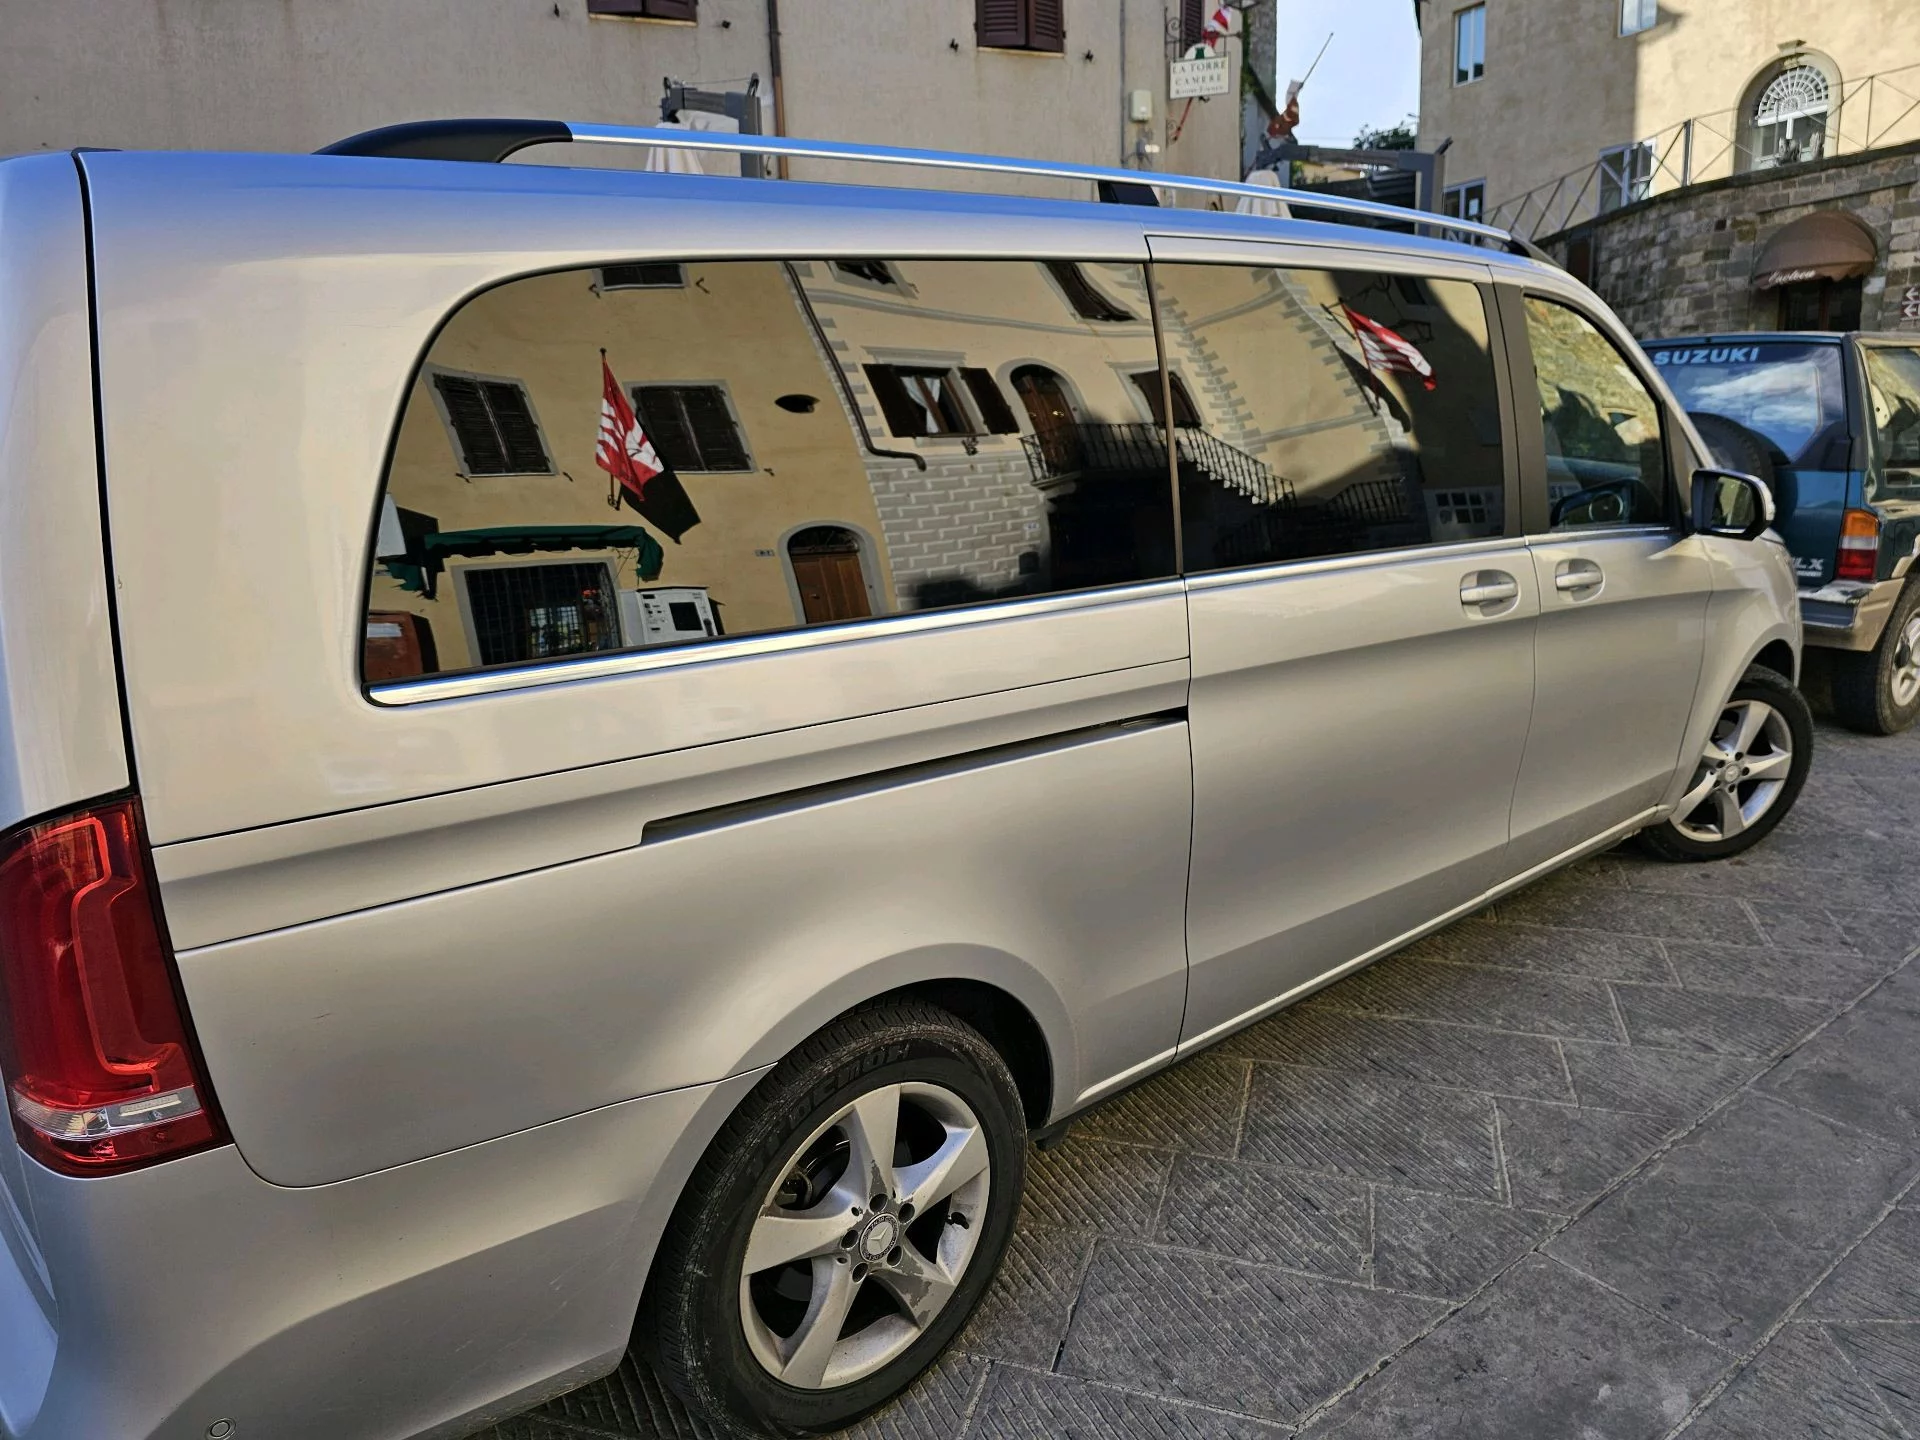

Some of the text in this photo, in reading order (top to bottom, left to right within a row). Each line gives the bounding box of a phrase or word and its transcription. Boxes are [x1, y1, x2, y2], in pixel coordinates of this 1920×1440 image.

[1172, 60, 1226, 74] LA TORRE
[1175, 74, 1221, 85] CAMERE
[1653, 346, 1760, 365] SUZUKI
